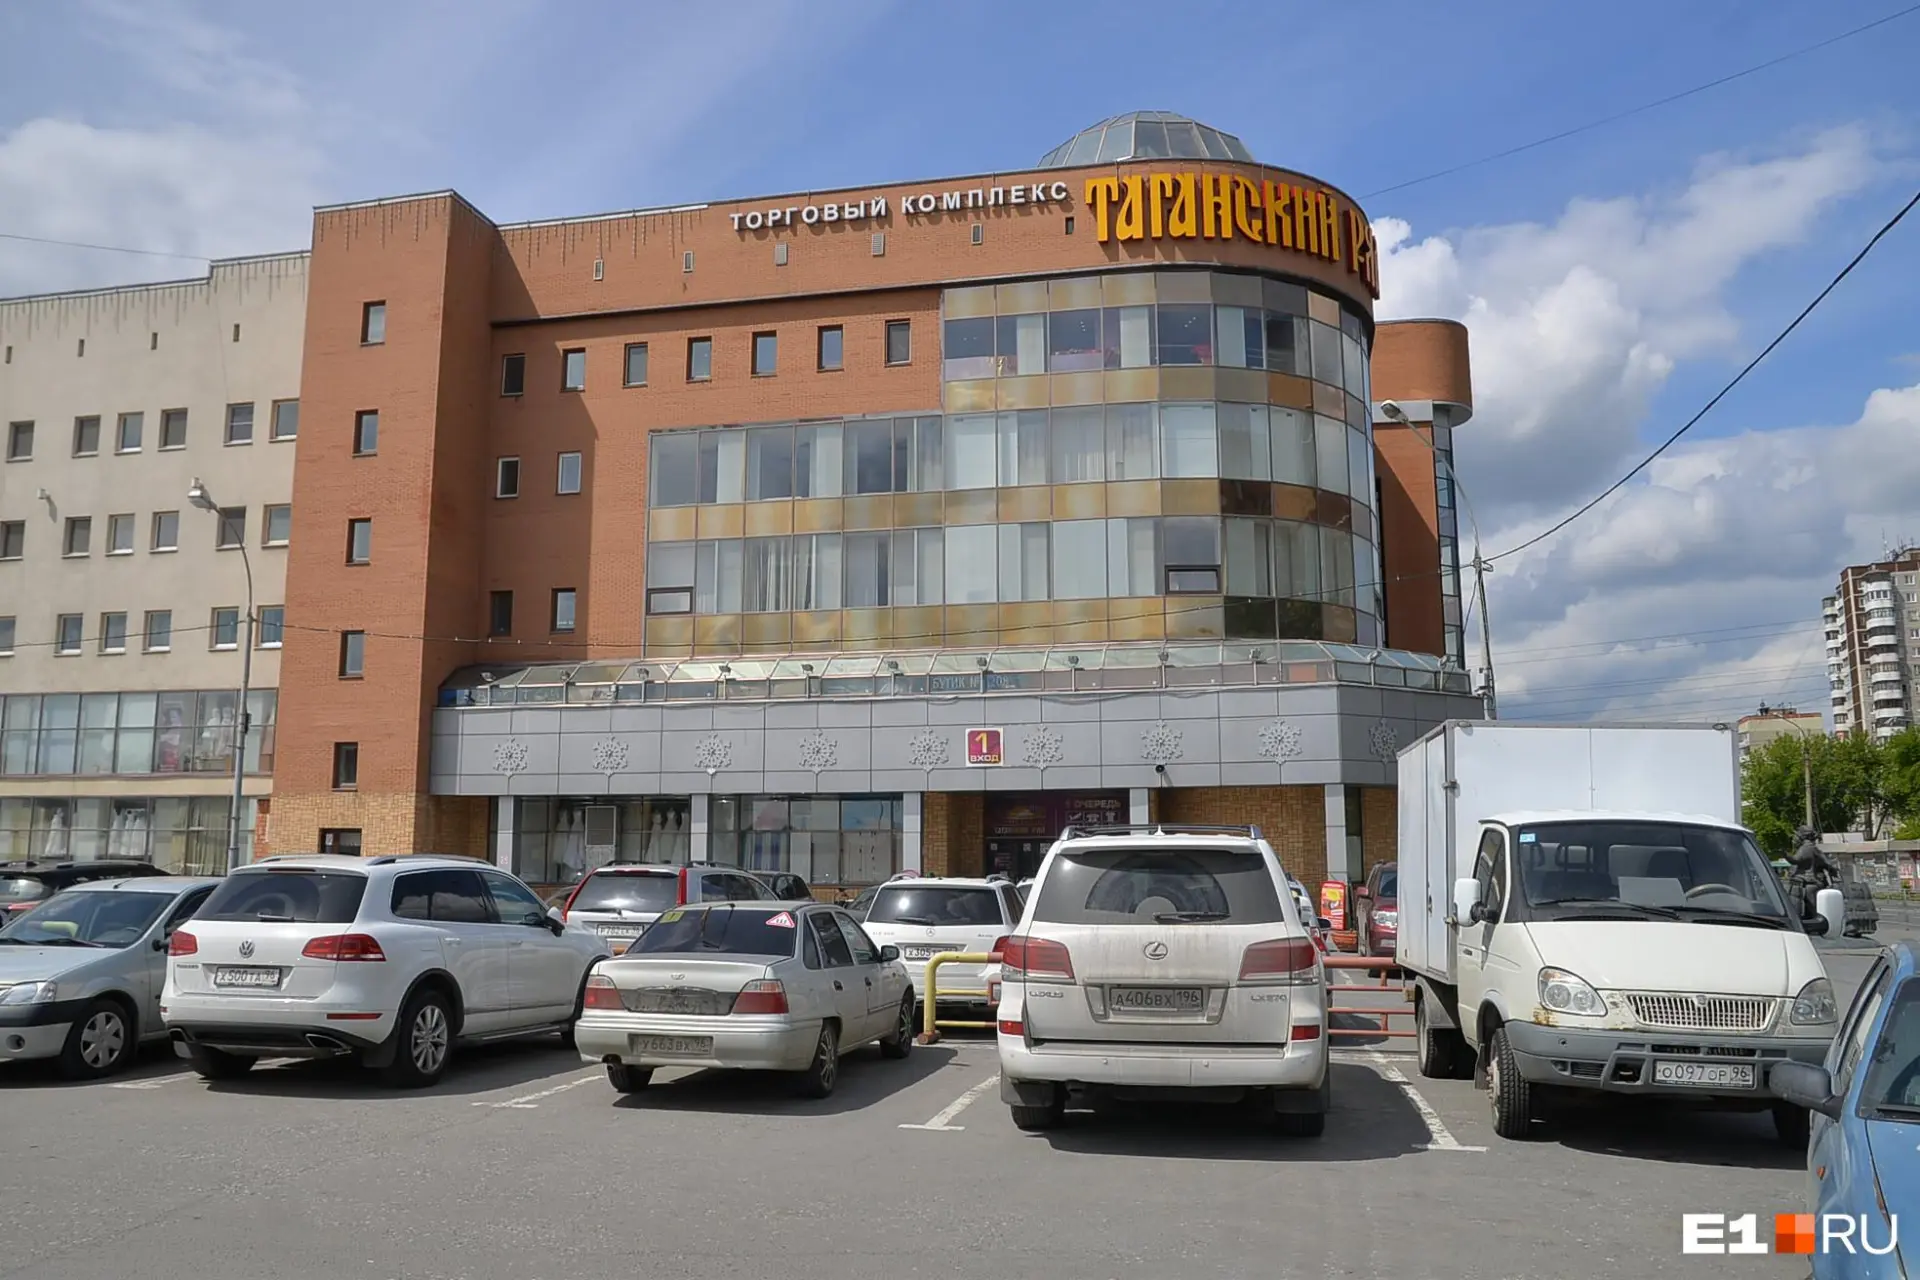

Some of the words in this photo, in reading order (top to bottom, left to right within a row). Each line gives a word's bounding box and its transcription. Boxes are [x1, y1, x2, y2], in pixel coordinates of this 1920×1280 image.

[729, 196, 886, 230] ТОРГОВЫЙ
[901, 181, 1067, 214] КОМПЛЕКС
[1085, 171, 1341, 262] ТАГАНСКИЙ
[1343, 207, 1380, 300] РЯ
[970, 755, 999, 763] ВХОД
[975, 732, 987, 753] 1
